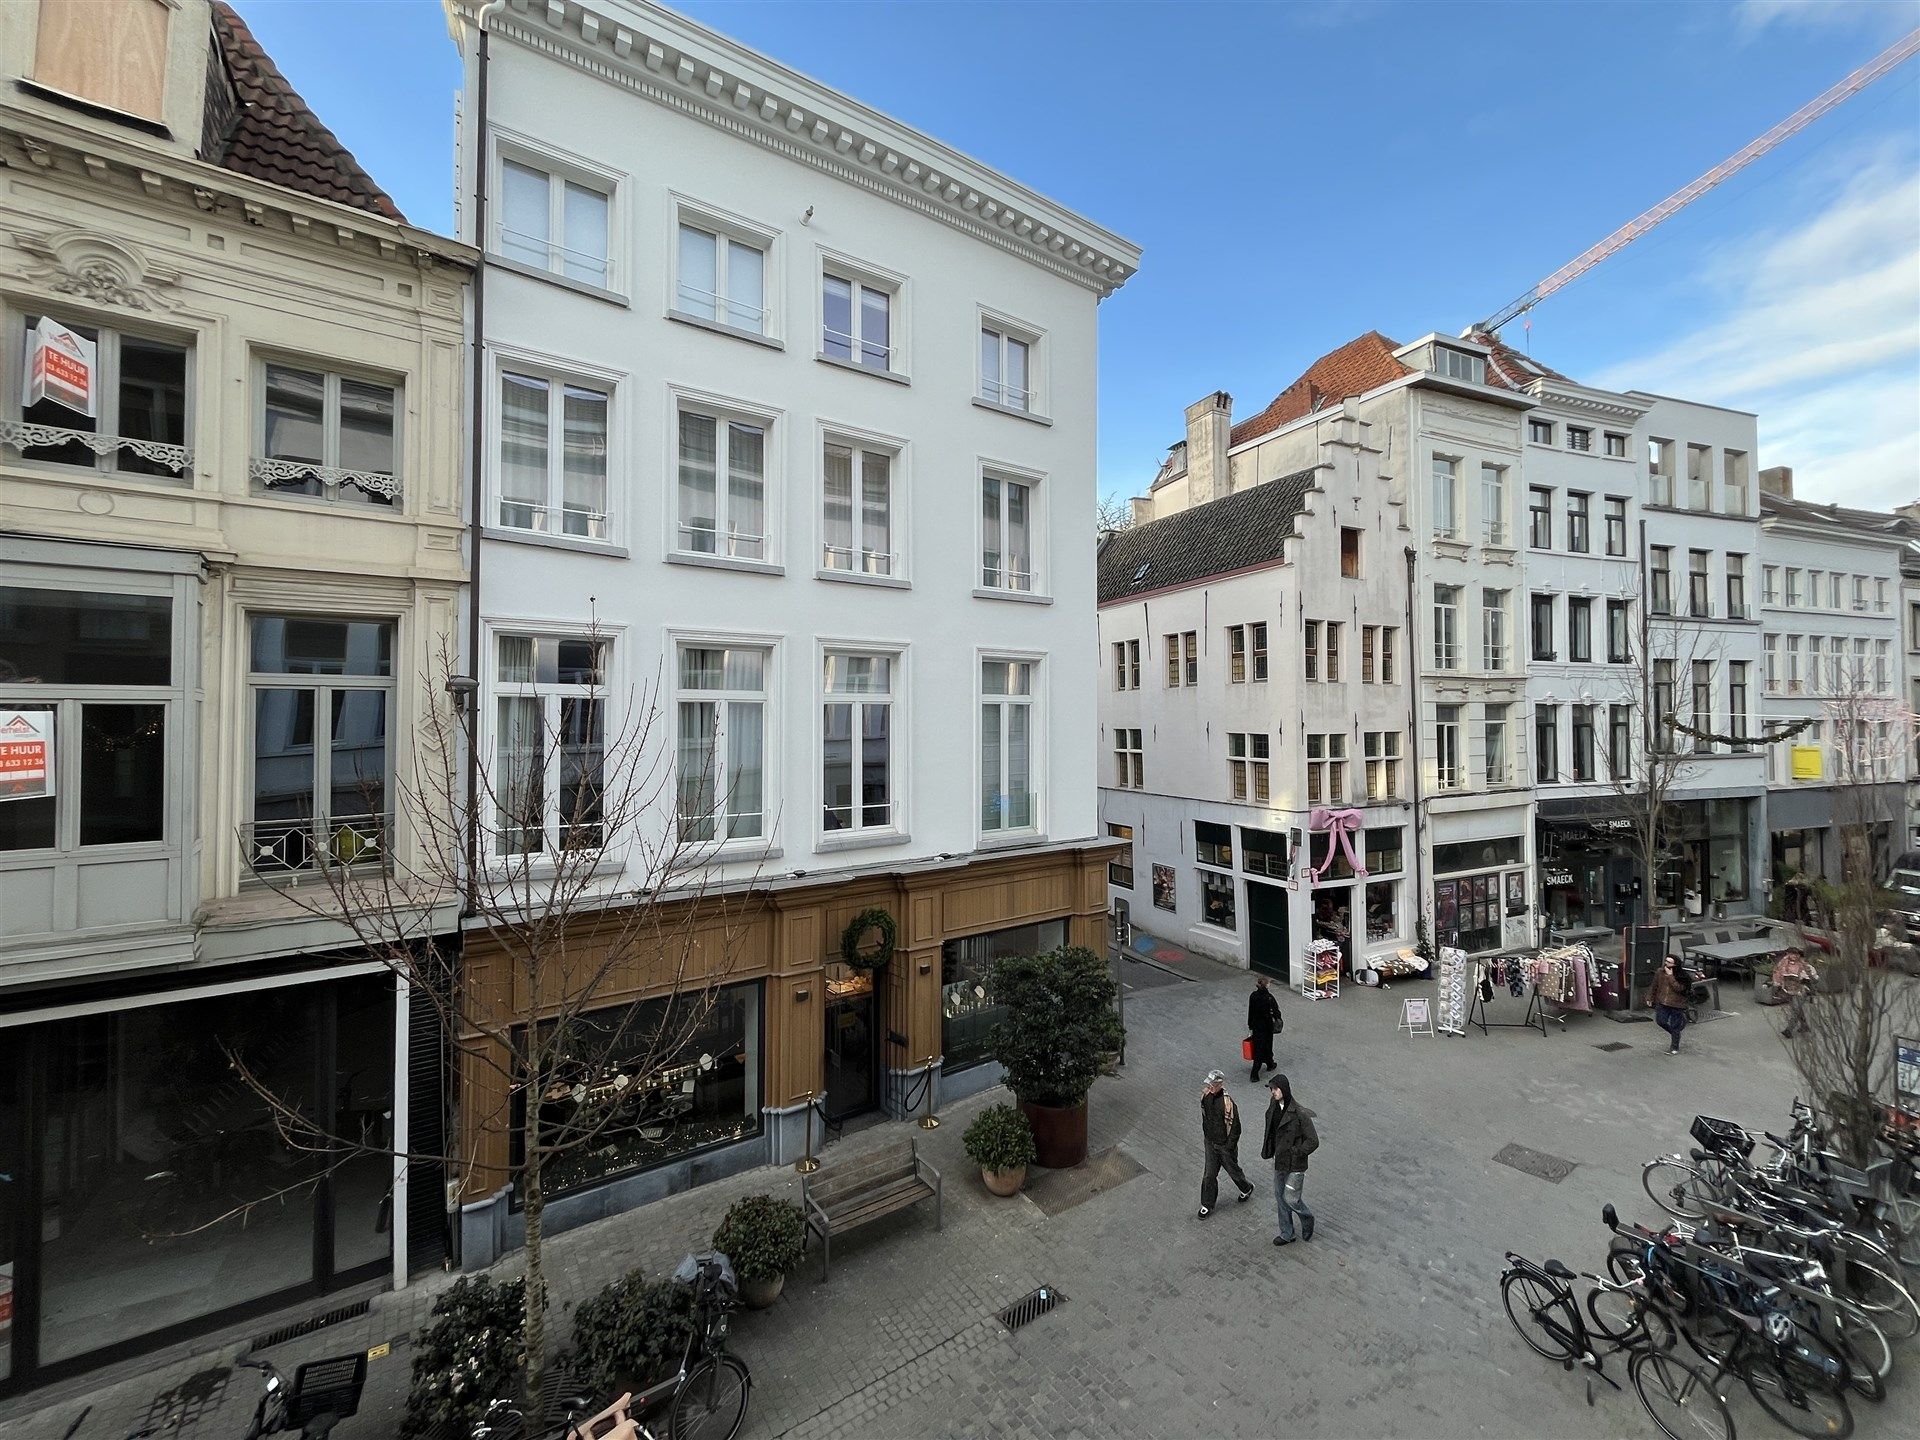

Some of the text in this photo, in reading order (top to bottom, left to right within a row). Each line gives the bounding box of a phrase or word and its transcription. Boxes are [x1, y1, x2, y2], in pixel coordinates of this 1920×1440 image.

[48, 350, 59, 362] TE
[60, 357, 86, 376] HUUR
[10, 745, 42, 755] HUUR
[5, 759, 21, 767] 633
[23, 758, 33, 766] 12
[35, 758, 44, 766] 36
[1608, 819, 1632, 828] SMAECK
[1546, 873, 1574, 886] SMAECK
